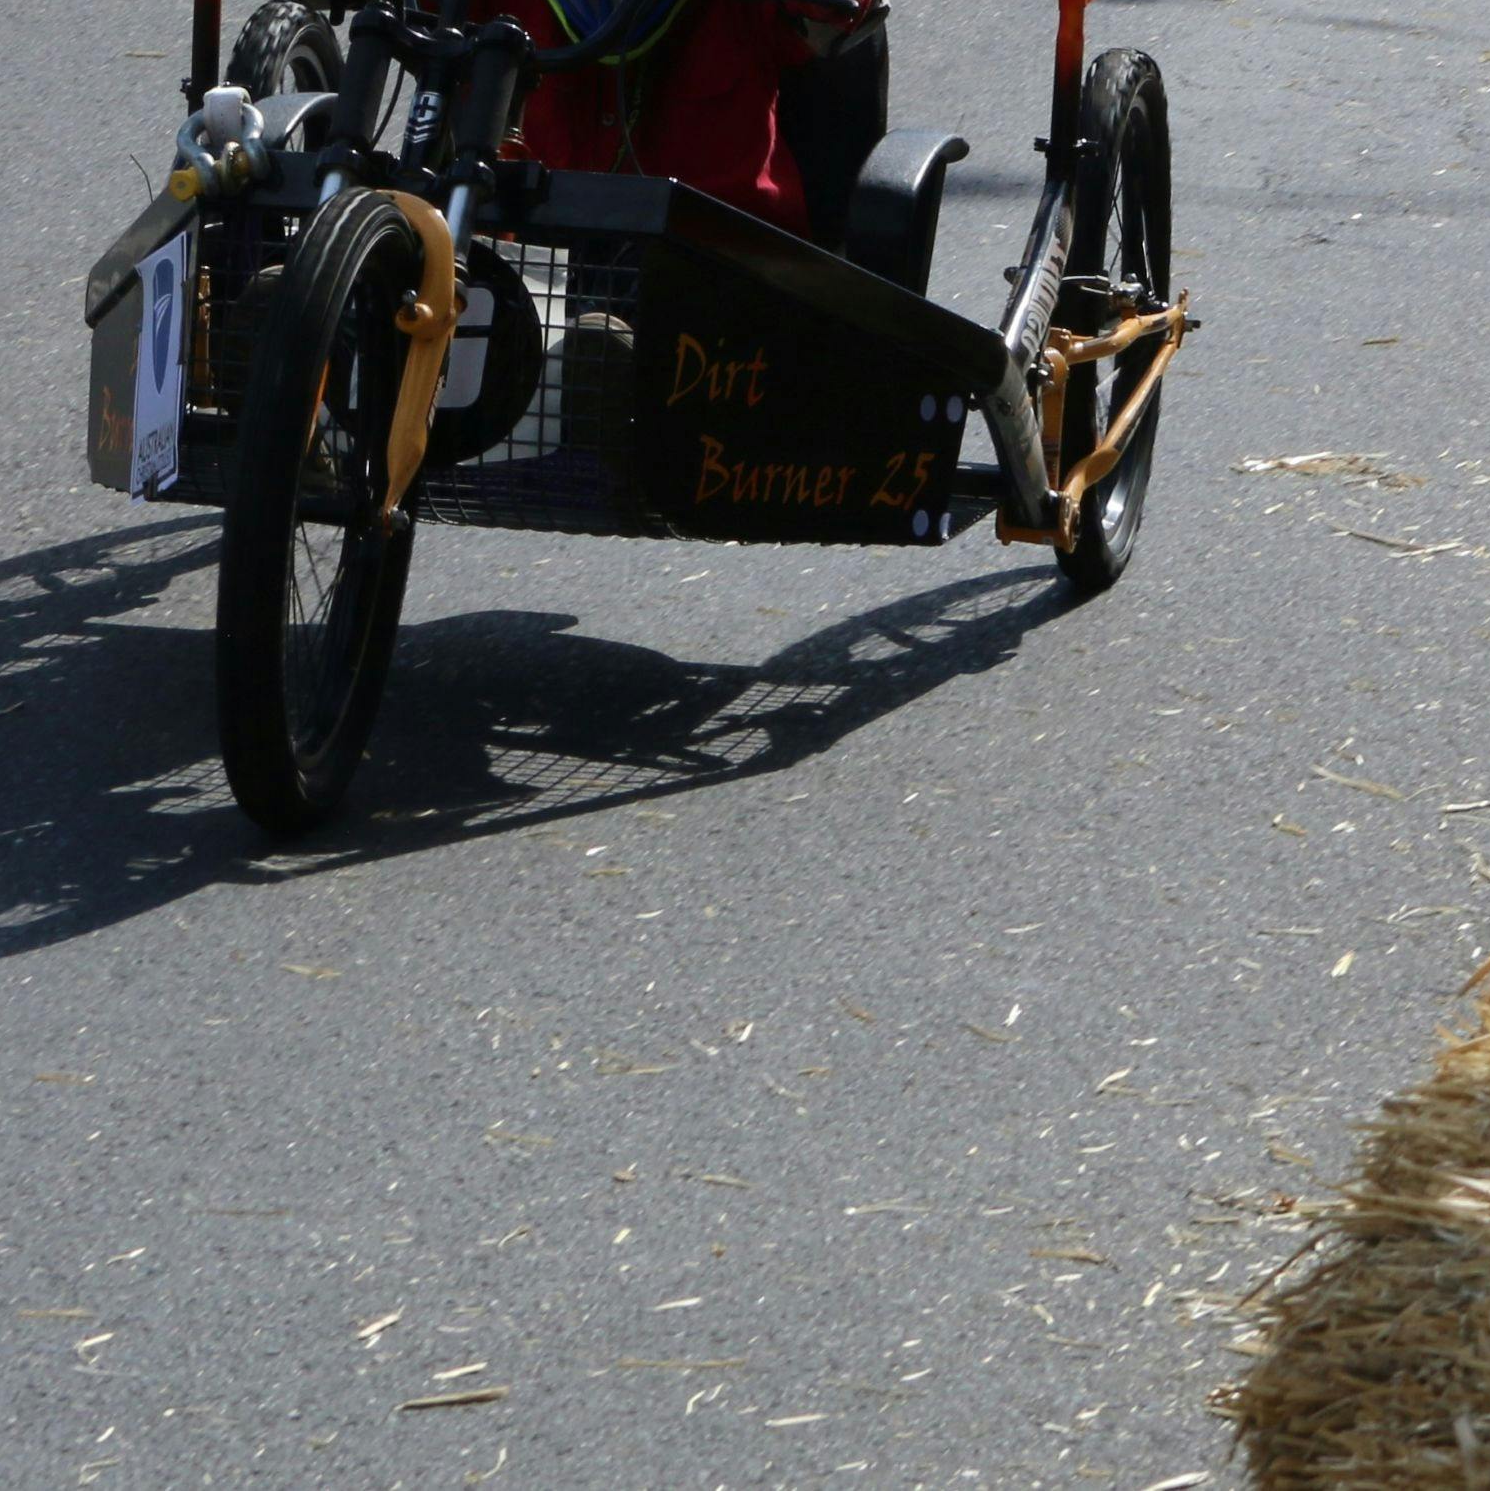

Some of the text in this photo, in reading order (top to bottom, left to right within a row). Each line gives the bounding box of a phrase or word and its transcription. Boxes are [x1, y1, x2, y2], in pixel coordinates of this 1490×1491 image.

[665, 332, 769, 408] Dirt
[693, 433, 936, 511] Burner 25
